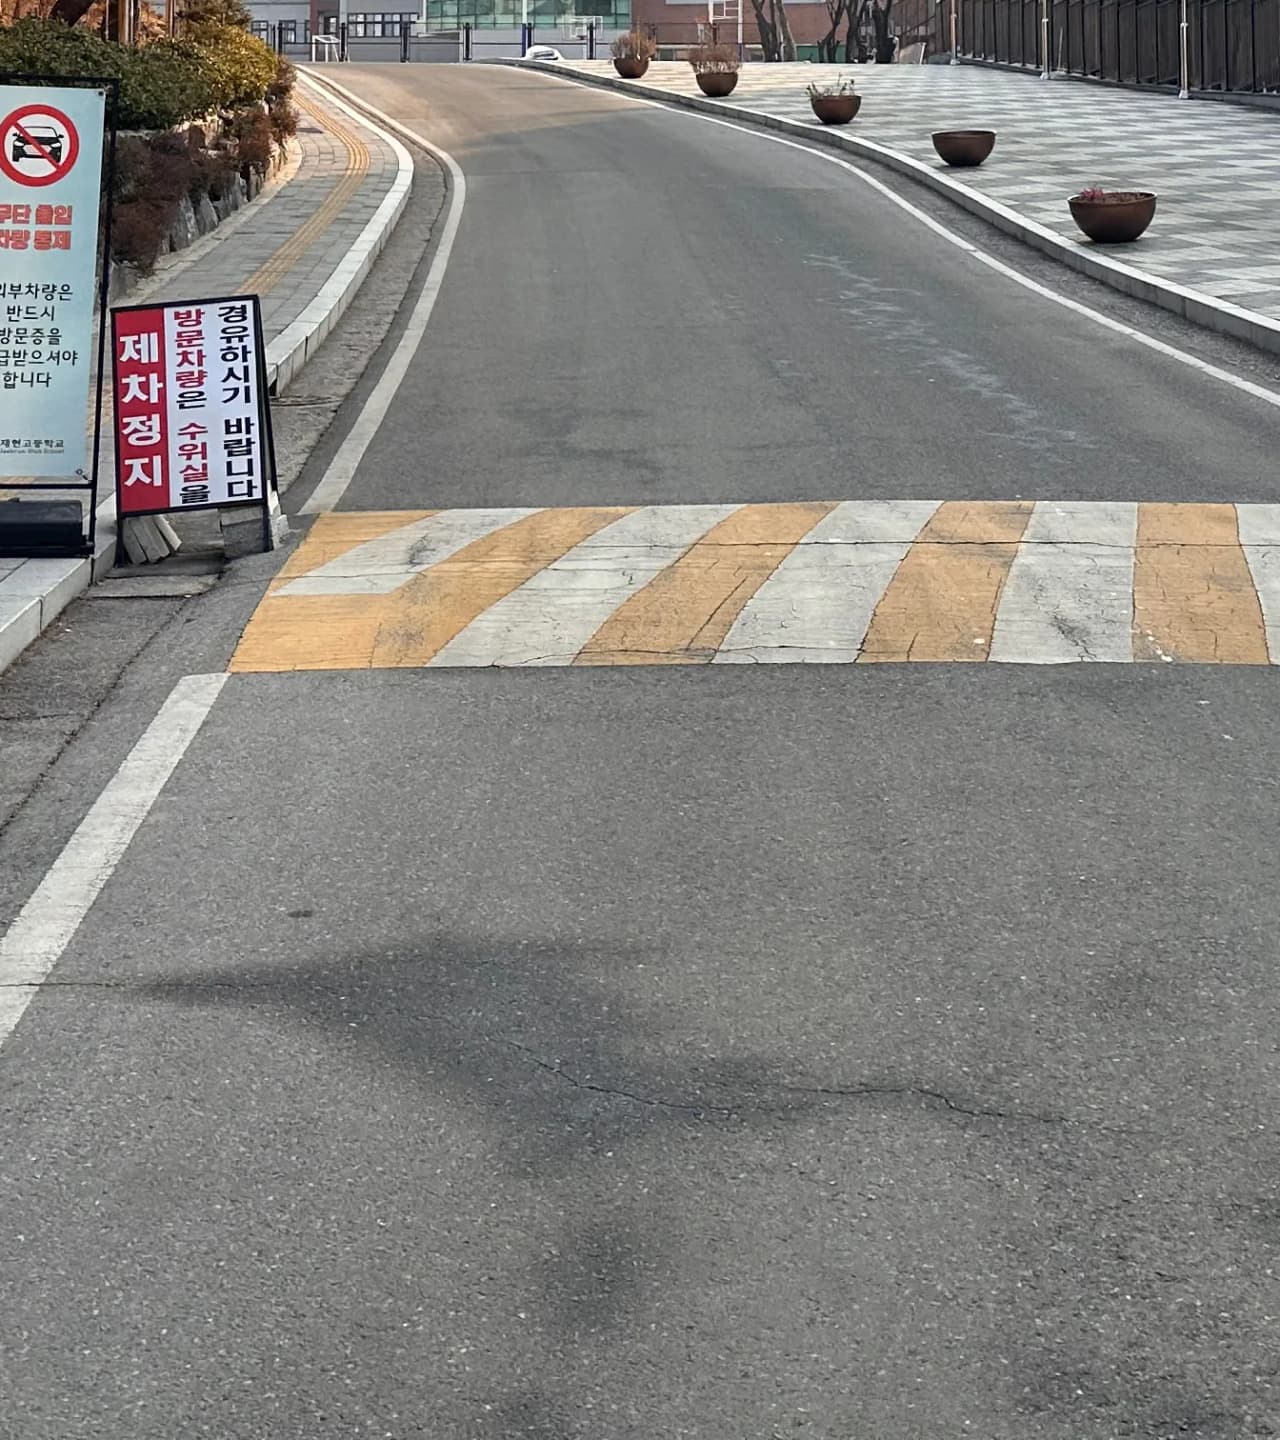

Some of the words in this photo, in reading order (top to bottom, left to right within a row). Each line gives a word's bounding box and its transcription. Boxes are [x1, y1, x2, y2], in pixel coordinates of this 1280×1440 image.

[33, 230, 72, 250] 통제
[6, 305, 55, 322] 반드시
[218, 304, 251, 404] 경유하시기
[2, 371, 52, 389] 합니다
[174, 308, 208, 410] 방문차량은
[120, 332, 163, 487] 제차정지
[177, 422, 210, 504] 수위실을
[224, 417, 258, 498] 바랍니다
